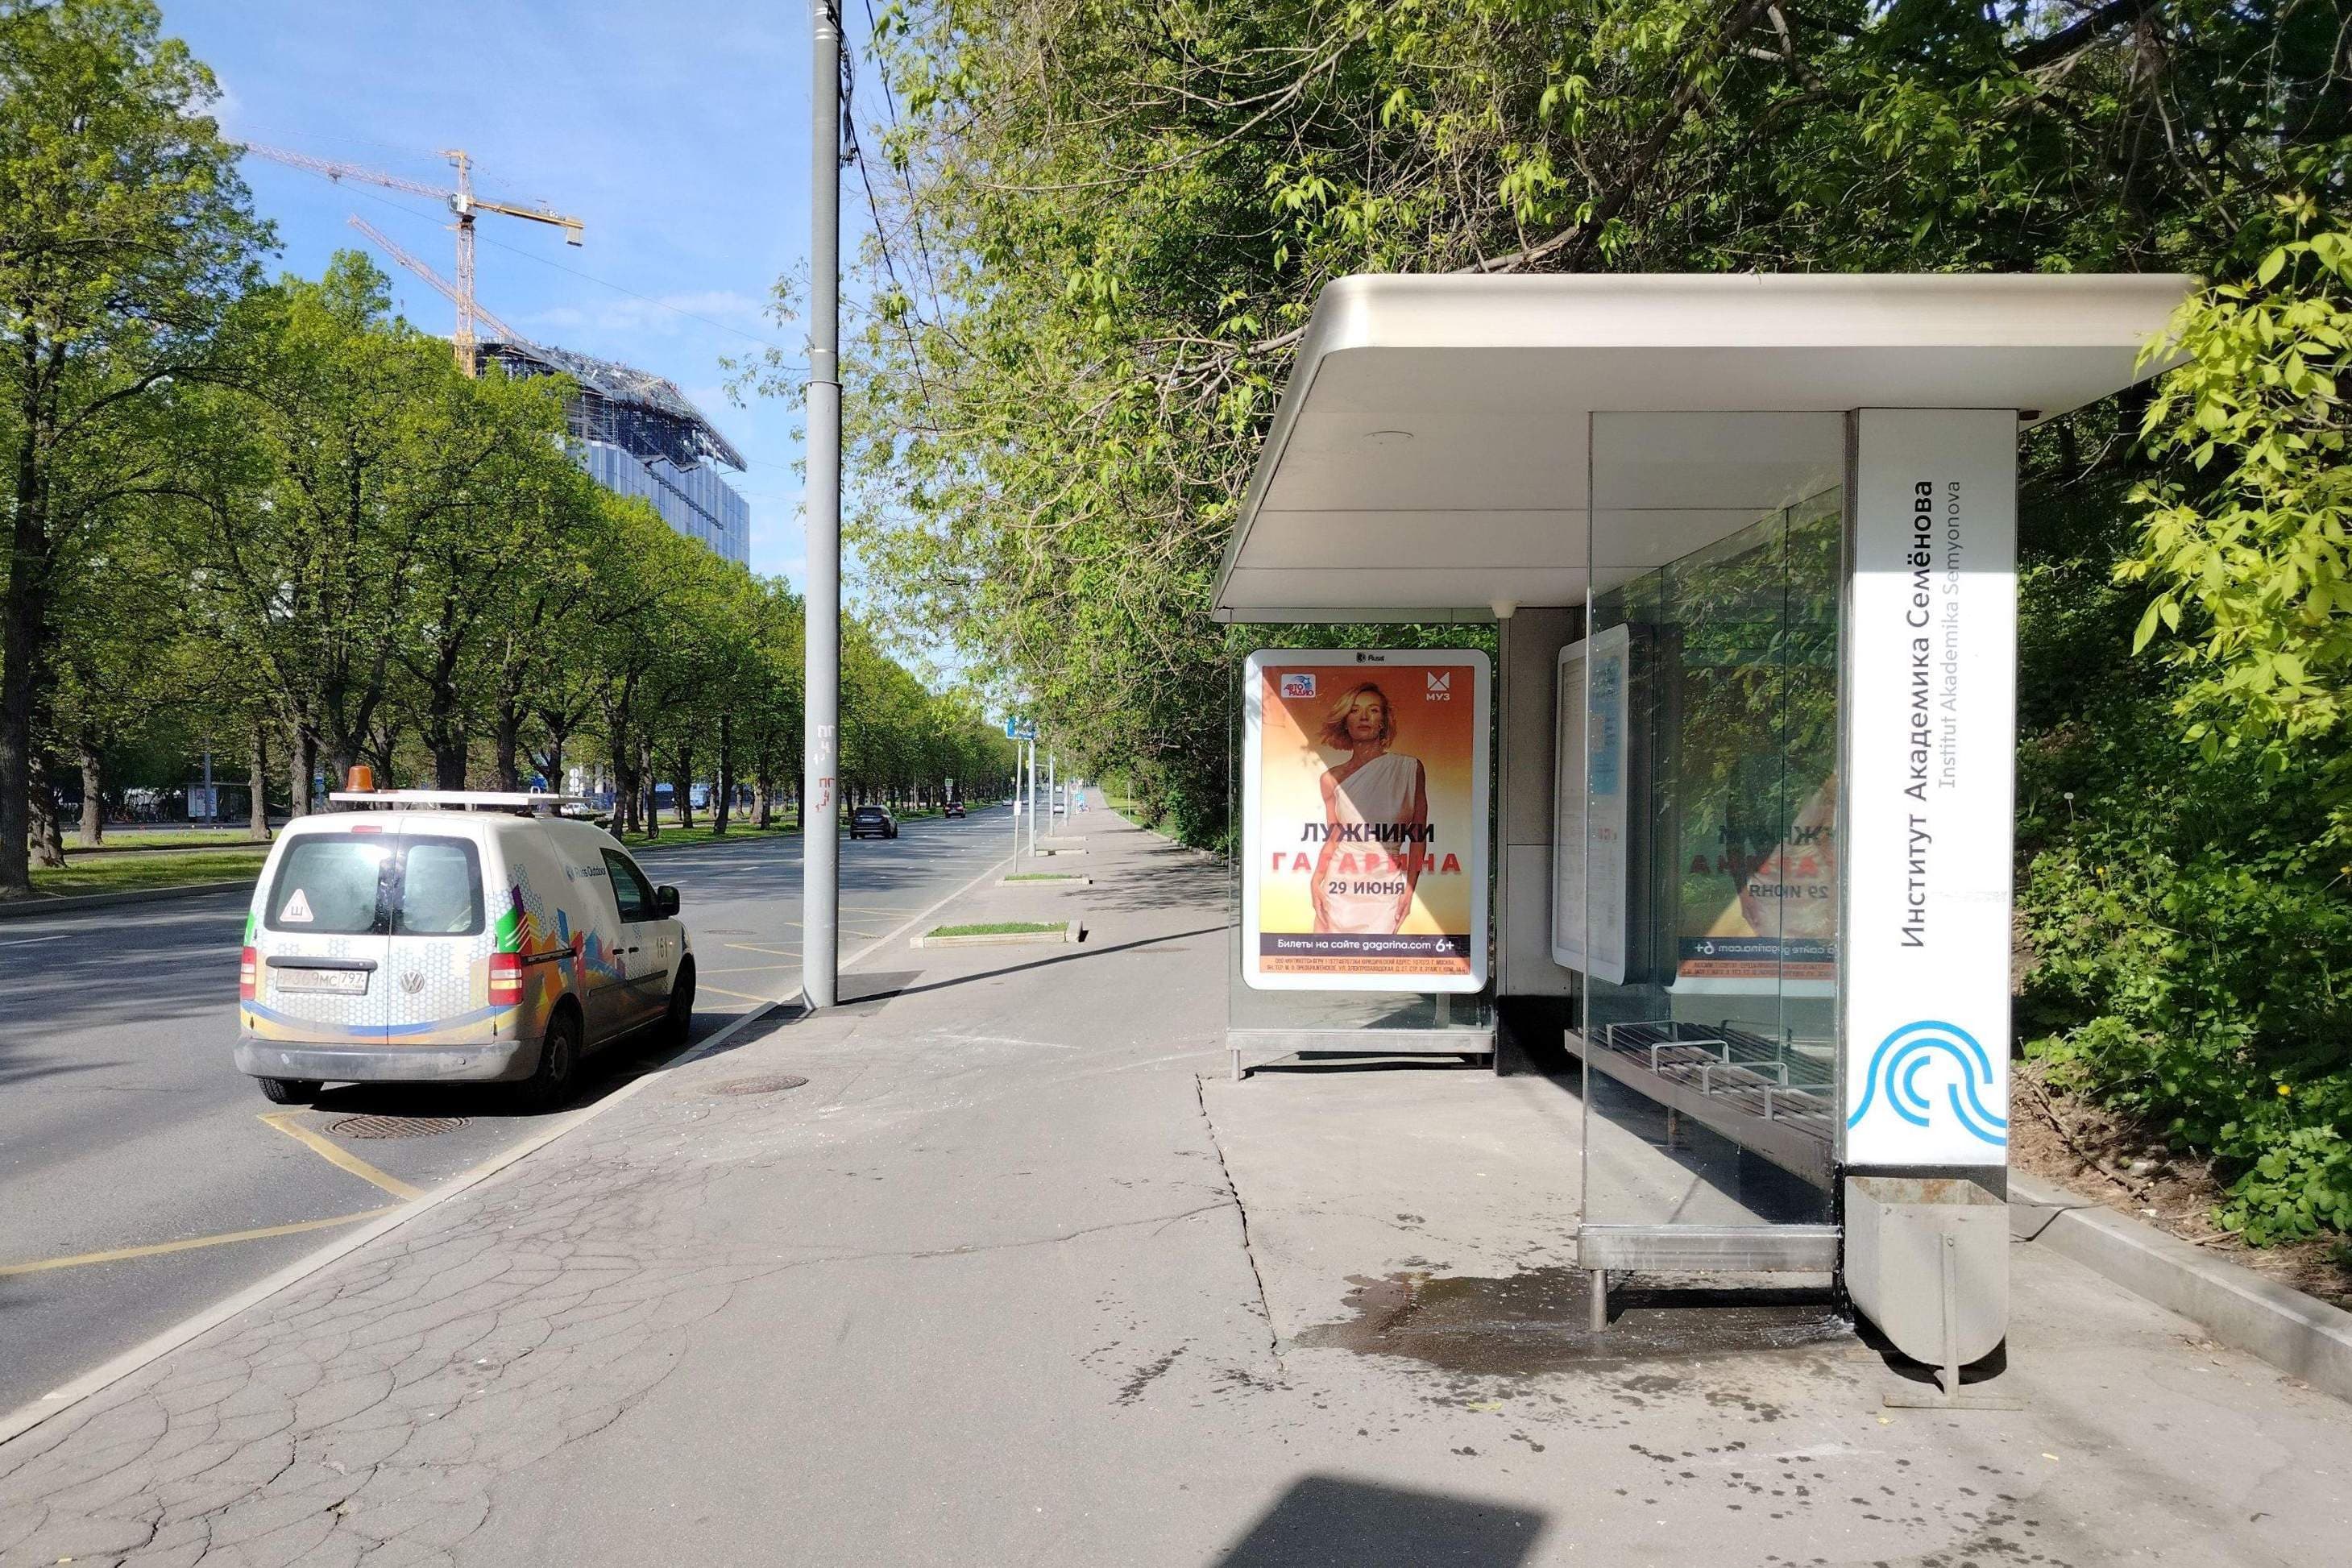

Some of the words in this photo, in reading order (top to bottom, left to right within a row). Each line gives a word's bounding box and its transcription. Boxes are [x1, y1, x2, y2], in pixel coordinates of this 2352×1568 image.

[1942, 481, 1964, 595] Semyonova
[1906, 480, 1932, 628] Семёнова
[1939, 601, 1959, 712] Akademika
[1426, 693, 1450, 701] МУЗ
[1903, 637, 1931, 803] Академика
[1938, 716, 1956, 789] Institut
[1300, 823, 1434, 843] ЛУЖНИКИ
[1271, 852, 1462, 873] ГАГАРИНА
[1329, 881, 1346, 894] 29
[1354, 881, 1405, 895] ИЮНЯ
[1901, 813, 1931, 948] Институт
[290, 906, 304, 916] Ш
[1277, 939, 1314, 948] Билеты
[1330, 940, 1360, 948] сайте
[1362, 940, 1431, 951] gagarina.com
[1435, 939, 1455, 952] 6+
[341, 972, 363, 984] 797
